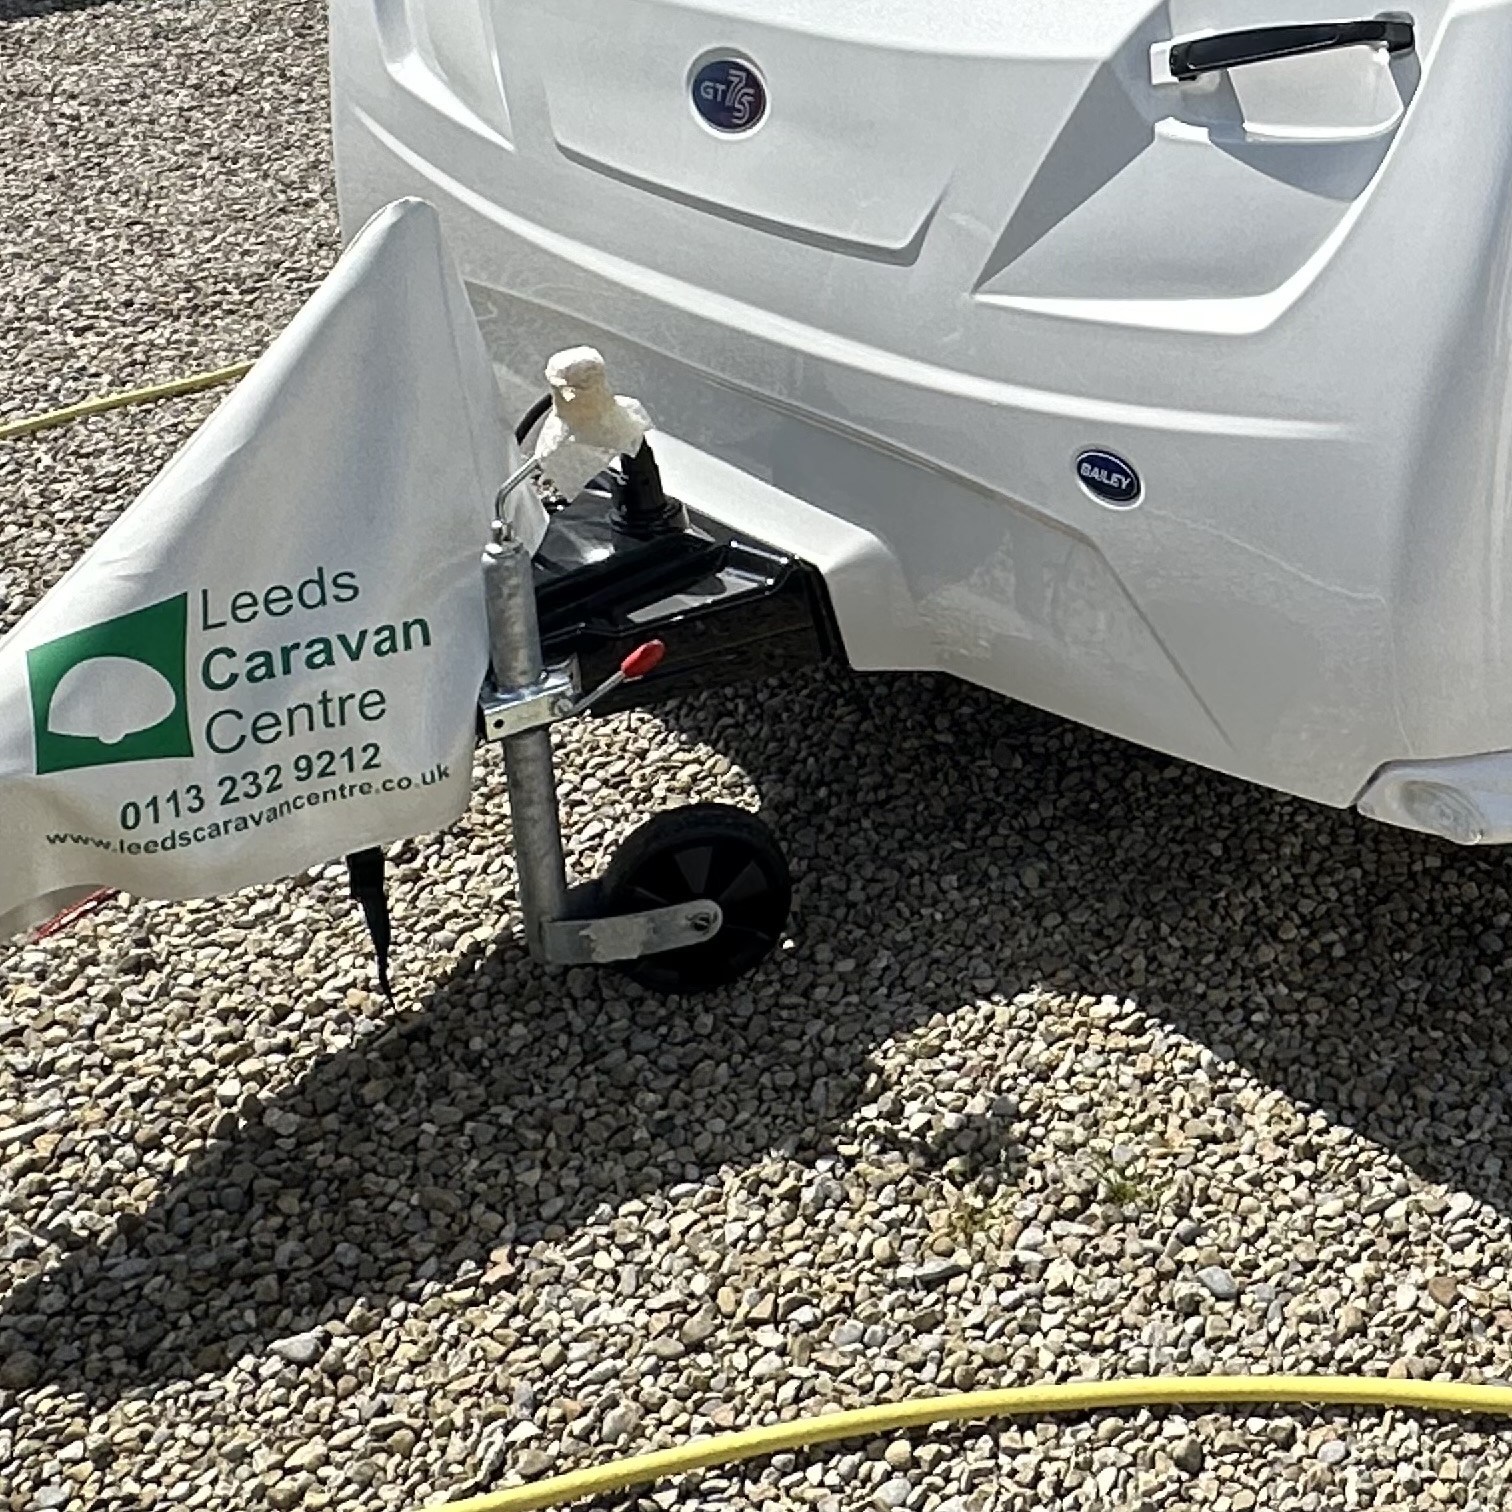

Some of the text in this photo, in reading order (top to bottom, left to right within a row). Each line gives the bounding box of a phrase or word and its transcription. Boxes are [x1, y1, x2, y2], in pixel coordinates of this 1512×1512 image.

[1080, 462, 1132, 490] BAILEY
[201, 566, 361, 632] Leeds
[201, 617, 433, 691] Caravan
[205, 688, 388, 755] Centre
[46, 762, 451, 856] www.leedscaravancentre.co.uk
[120, 742, 382, 831] 0113 232 9212
